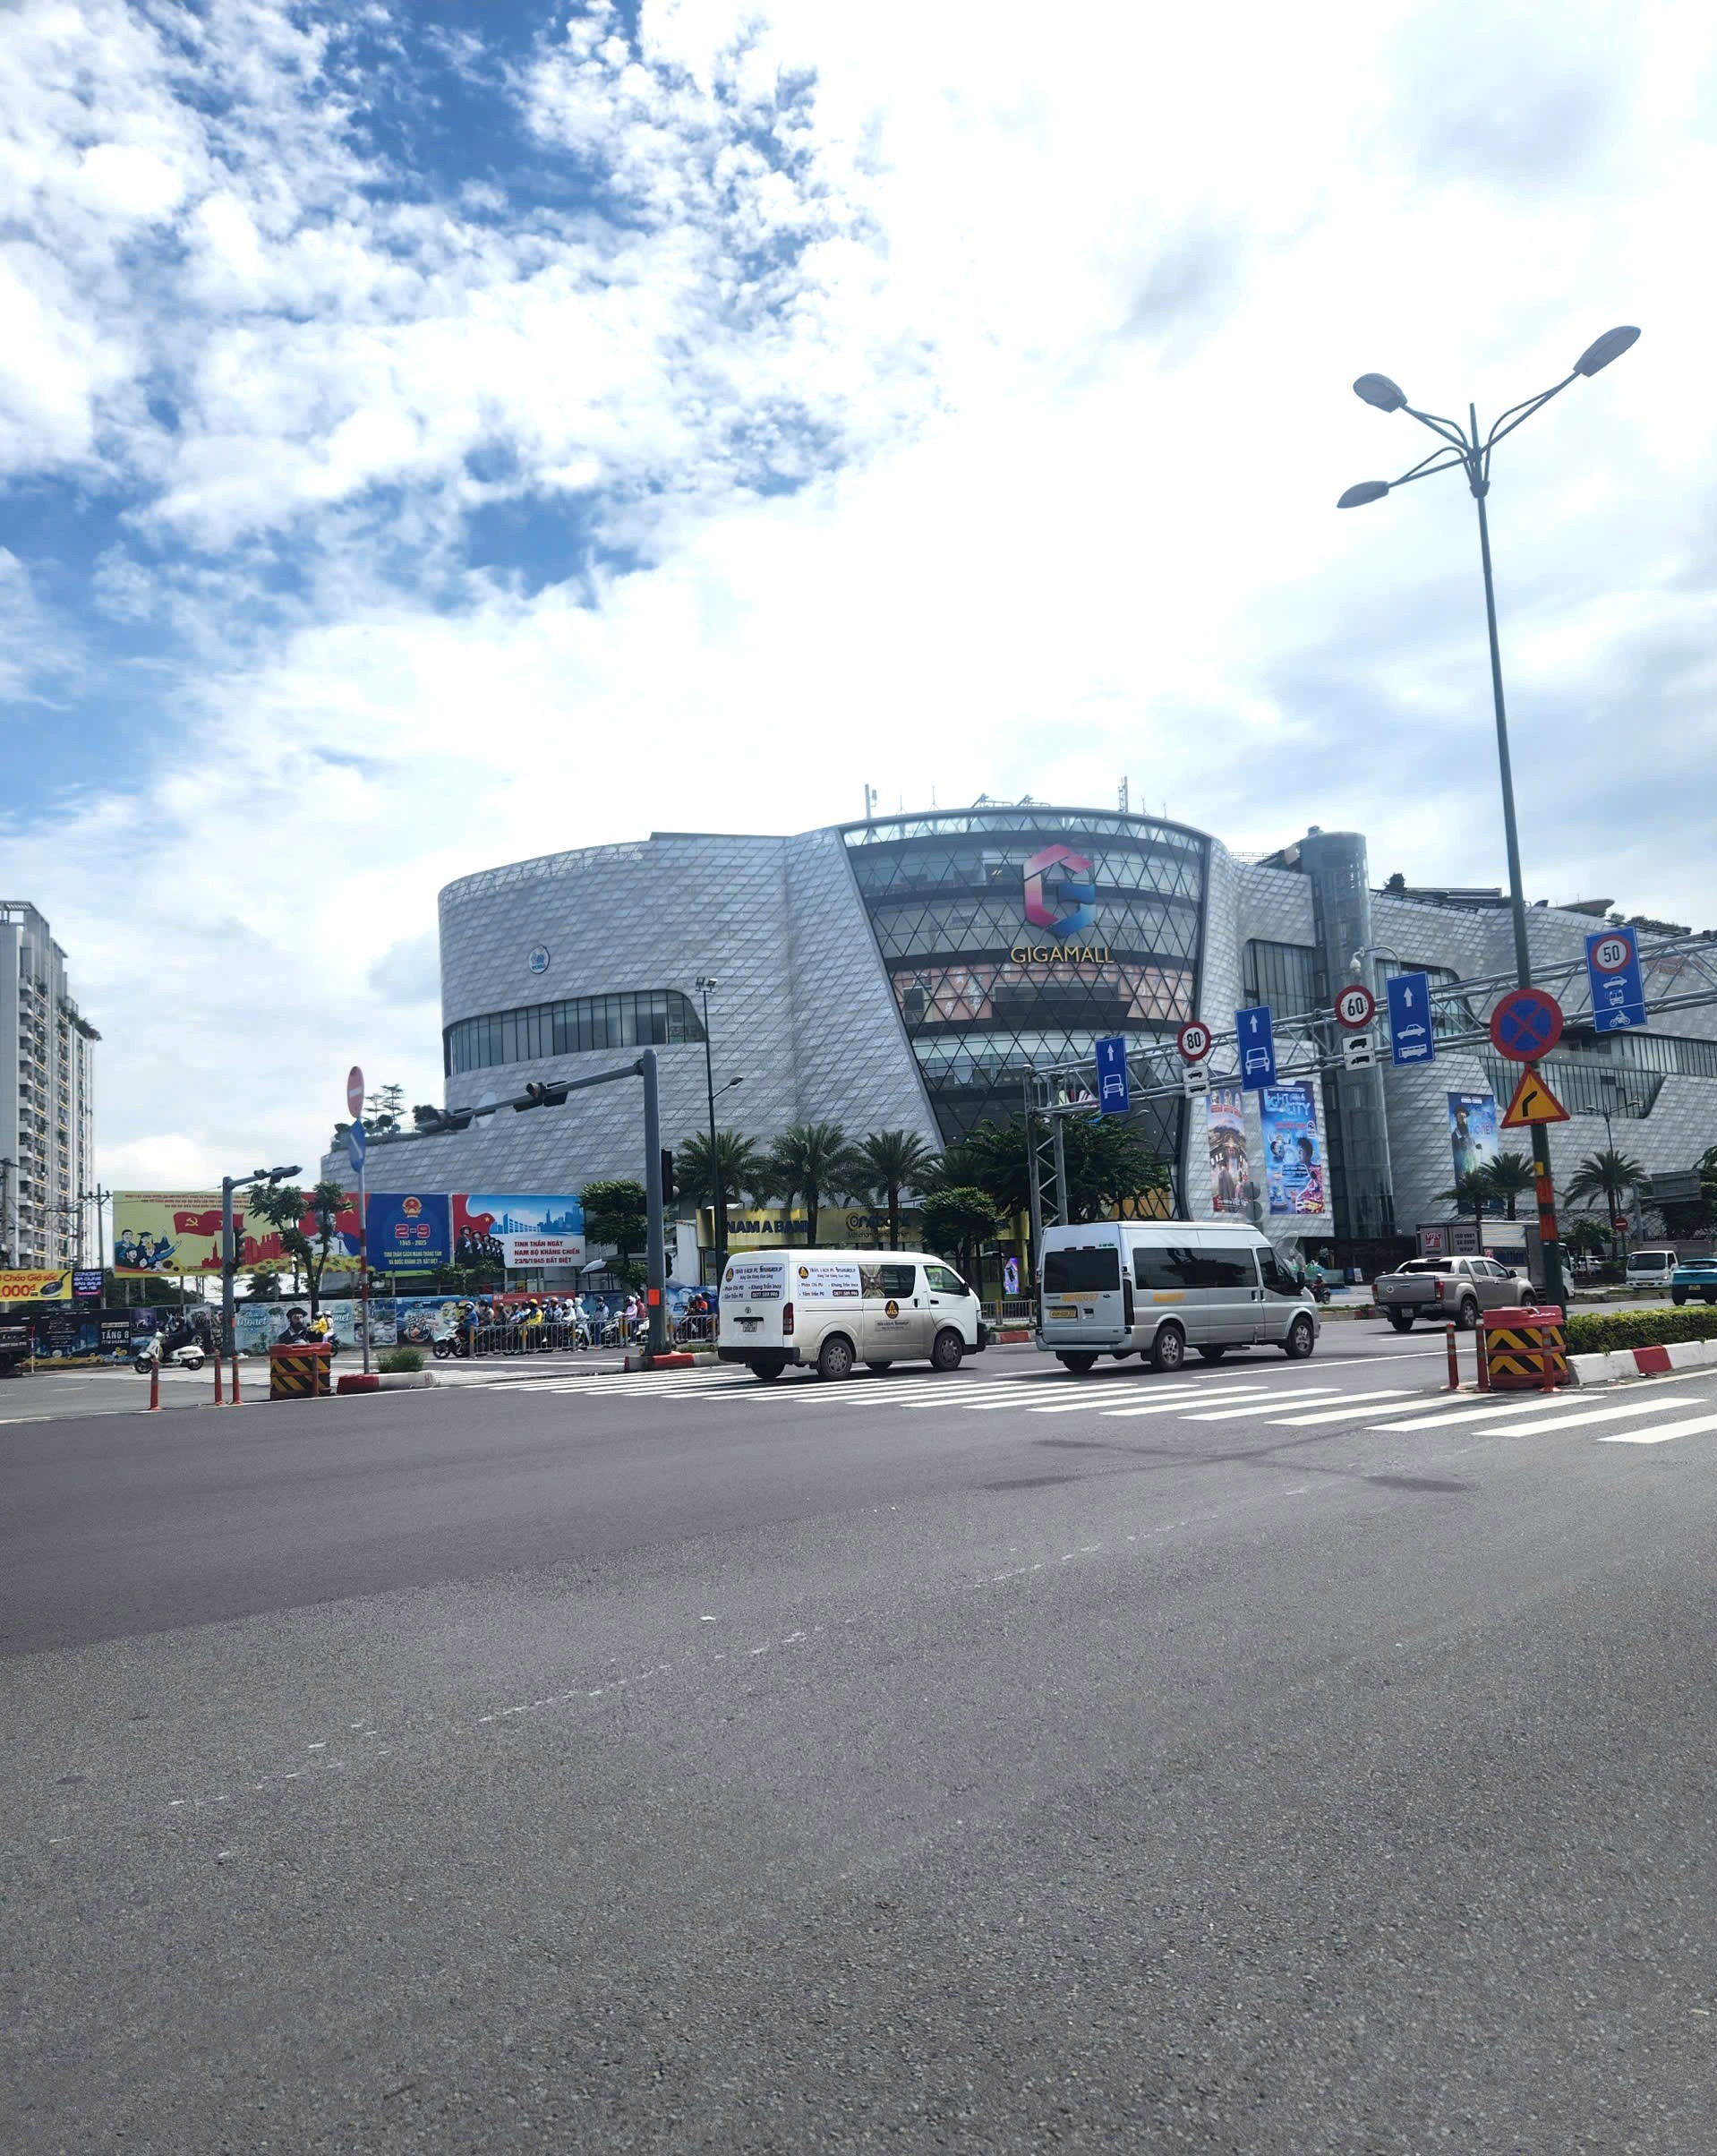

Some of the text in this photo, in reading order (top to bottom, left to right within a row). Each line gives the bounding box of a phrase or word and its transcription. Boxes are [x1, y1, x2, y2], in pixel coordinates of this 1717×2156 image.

[1010, 945, 1115, 963] GIGAMALL
[1603, 945, 1620, 962] 50
[1347, 997, 1364, 1017] 60
[1186, 1031, 1201, 1049] 80
[395, 1223, 431, 1239] 2-9
[726, 1220, 761, 1233] NAM
[762, 1220, 773, 1233] A
[124, 1330, 130, 1339] 8
